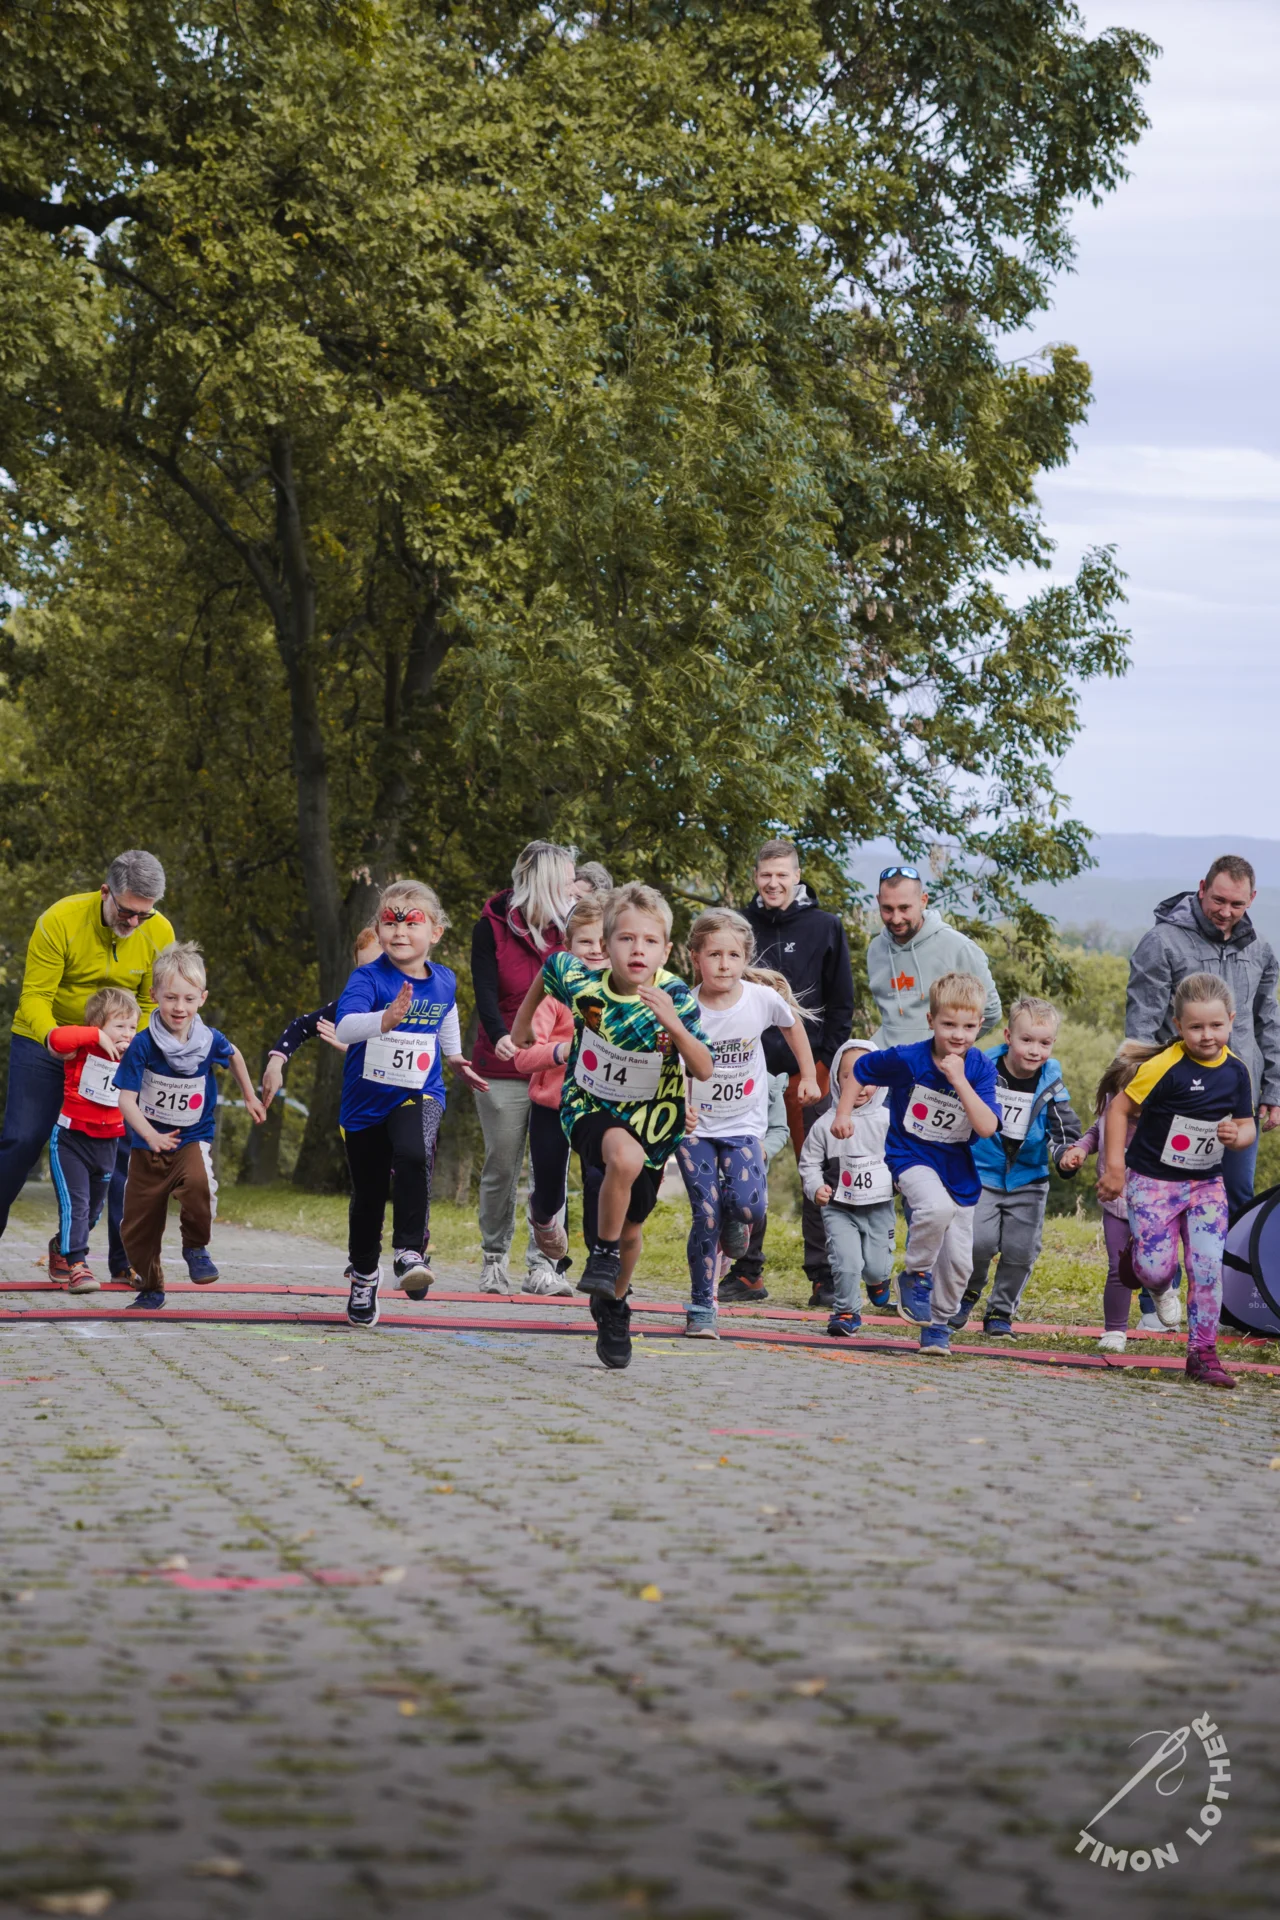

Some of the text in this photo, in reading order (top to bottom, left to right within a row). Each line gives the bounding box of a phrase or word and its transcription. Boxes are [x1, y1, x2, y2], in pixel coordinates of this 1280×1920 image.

[392, 1049, 414, 1070] 51
[592, 1040, 648, 1065] Limberglauf Ranis
[103, 1075, 117, 1092] 1
[150, 1077, 183, 1090] Limberglauf
[603, 1062, 627, 1086] 14
[155, 1091, 189, 1111] 215
[712, 1082, 743, 1102] 205
[923, 1093, 958, 1109] Limberglauf
[629, 1101, 678, 1144] 10
[931, 1109, 956, 1130] 52
[1004, 1105, 1023, 1123] 77
[1194, 1137, 1215, 1155] 76
[853, 1171, 873, 1190] 48
